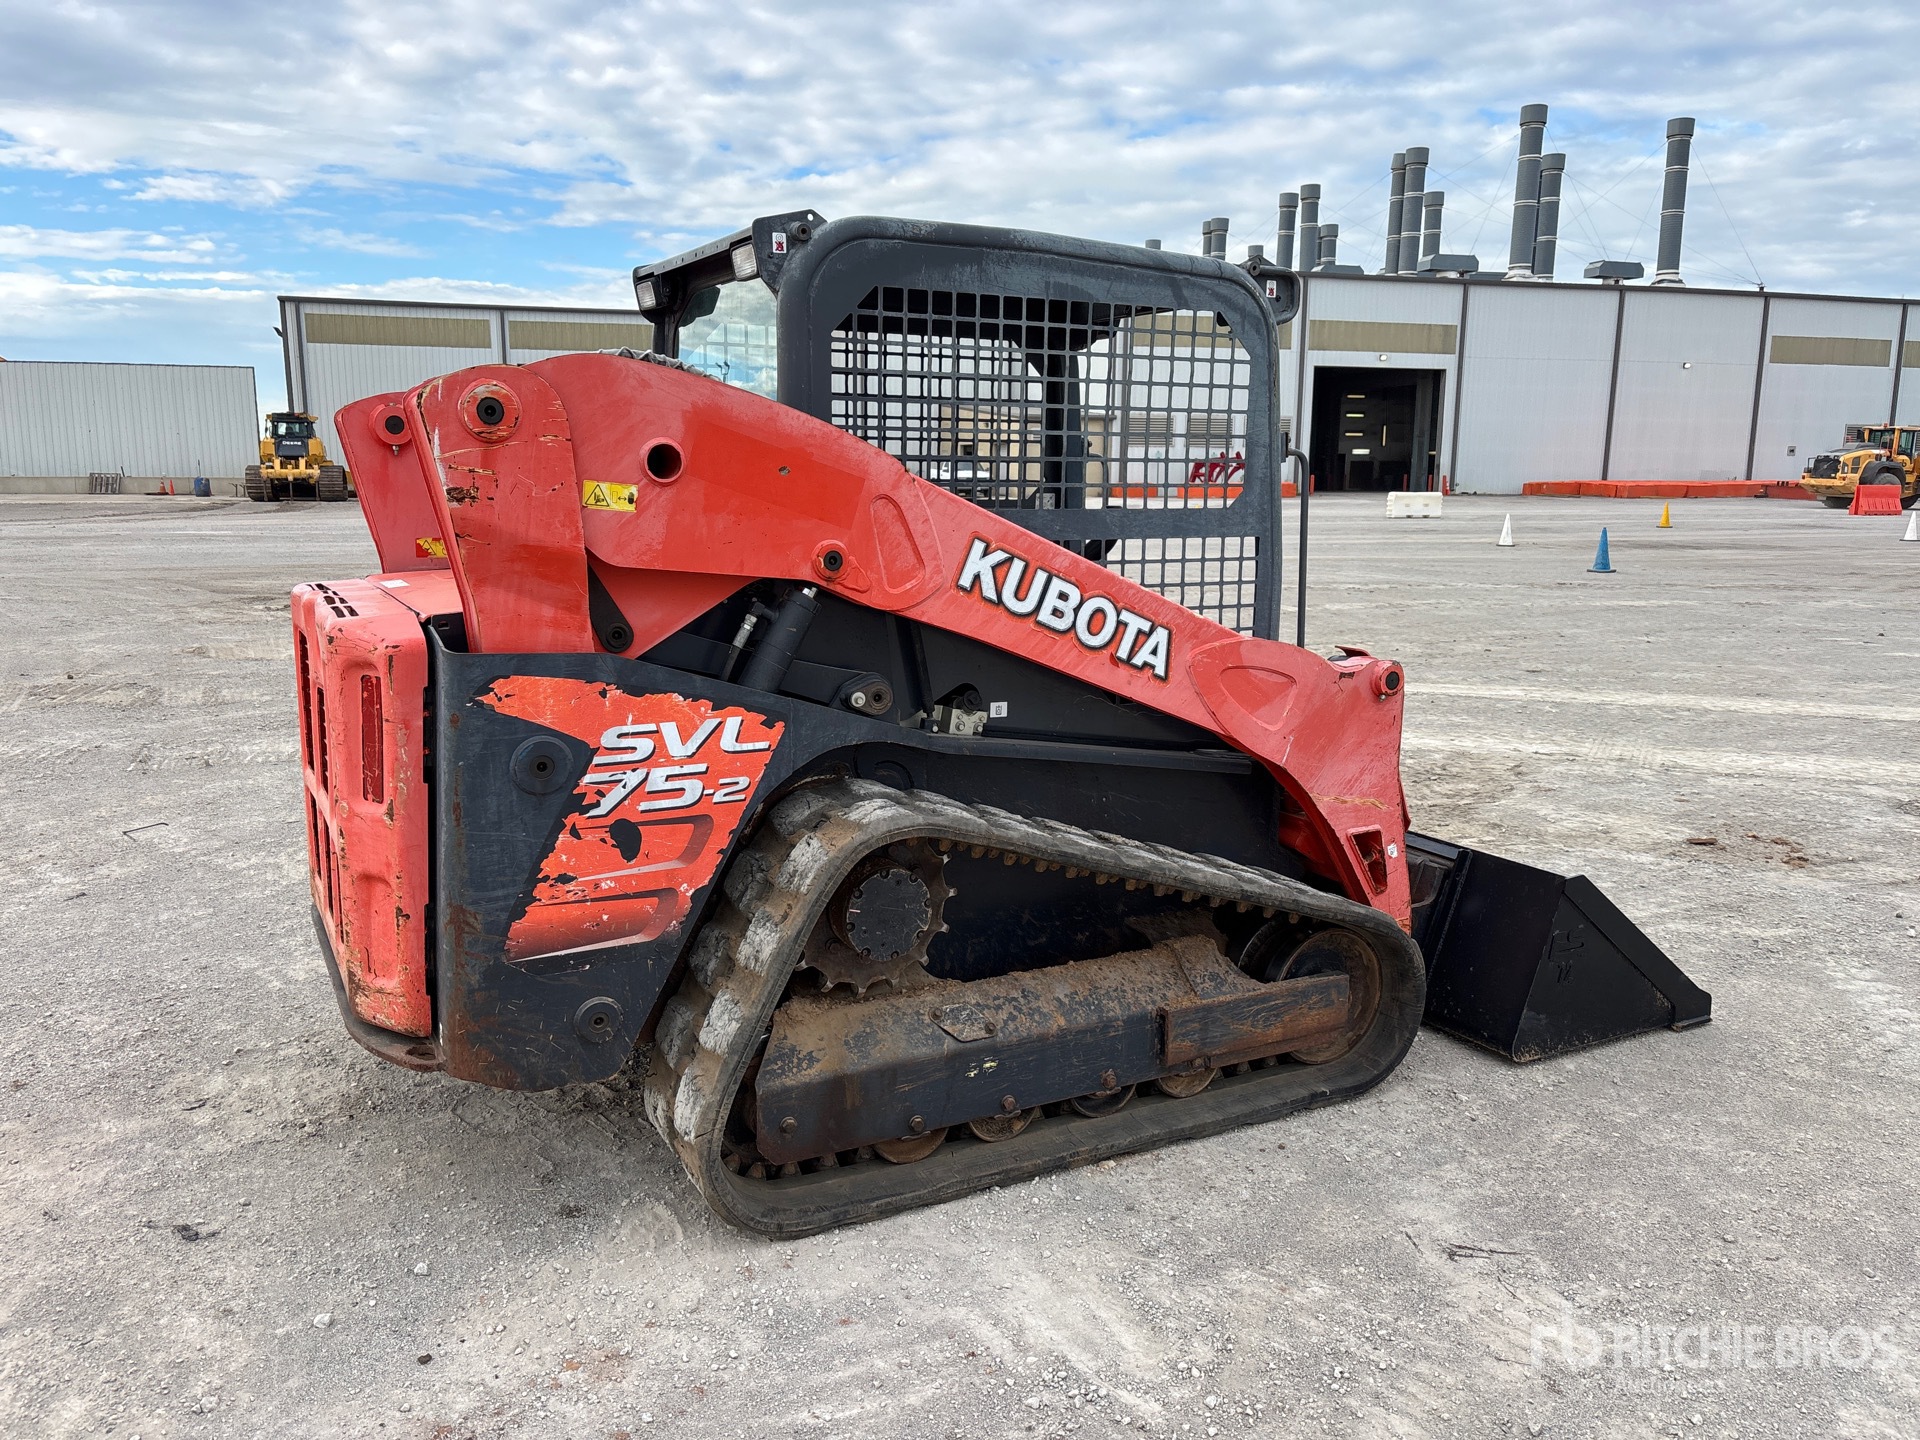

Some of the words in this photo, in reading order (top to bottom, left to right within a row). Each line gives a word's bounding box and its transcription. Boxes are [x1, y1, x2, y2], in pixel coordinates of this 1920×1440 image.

[957, 537, 1171, 681] KUBOTA
[592, 716, 771, 766] SVL
[583, 763, 750, 818] 75-2
